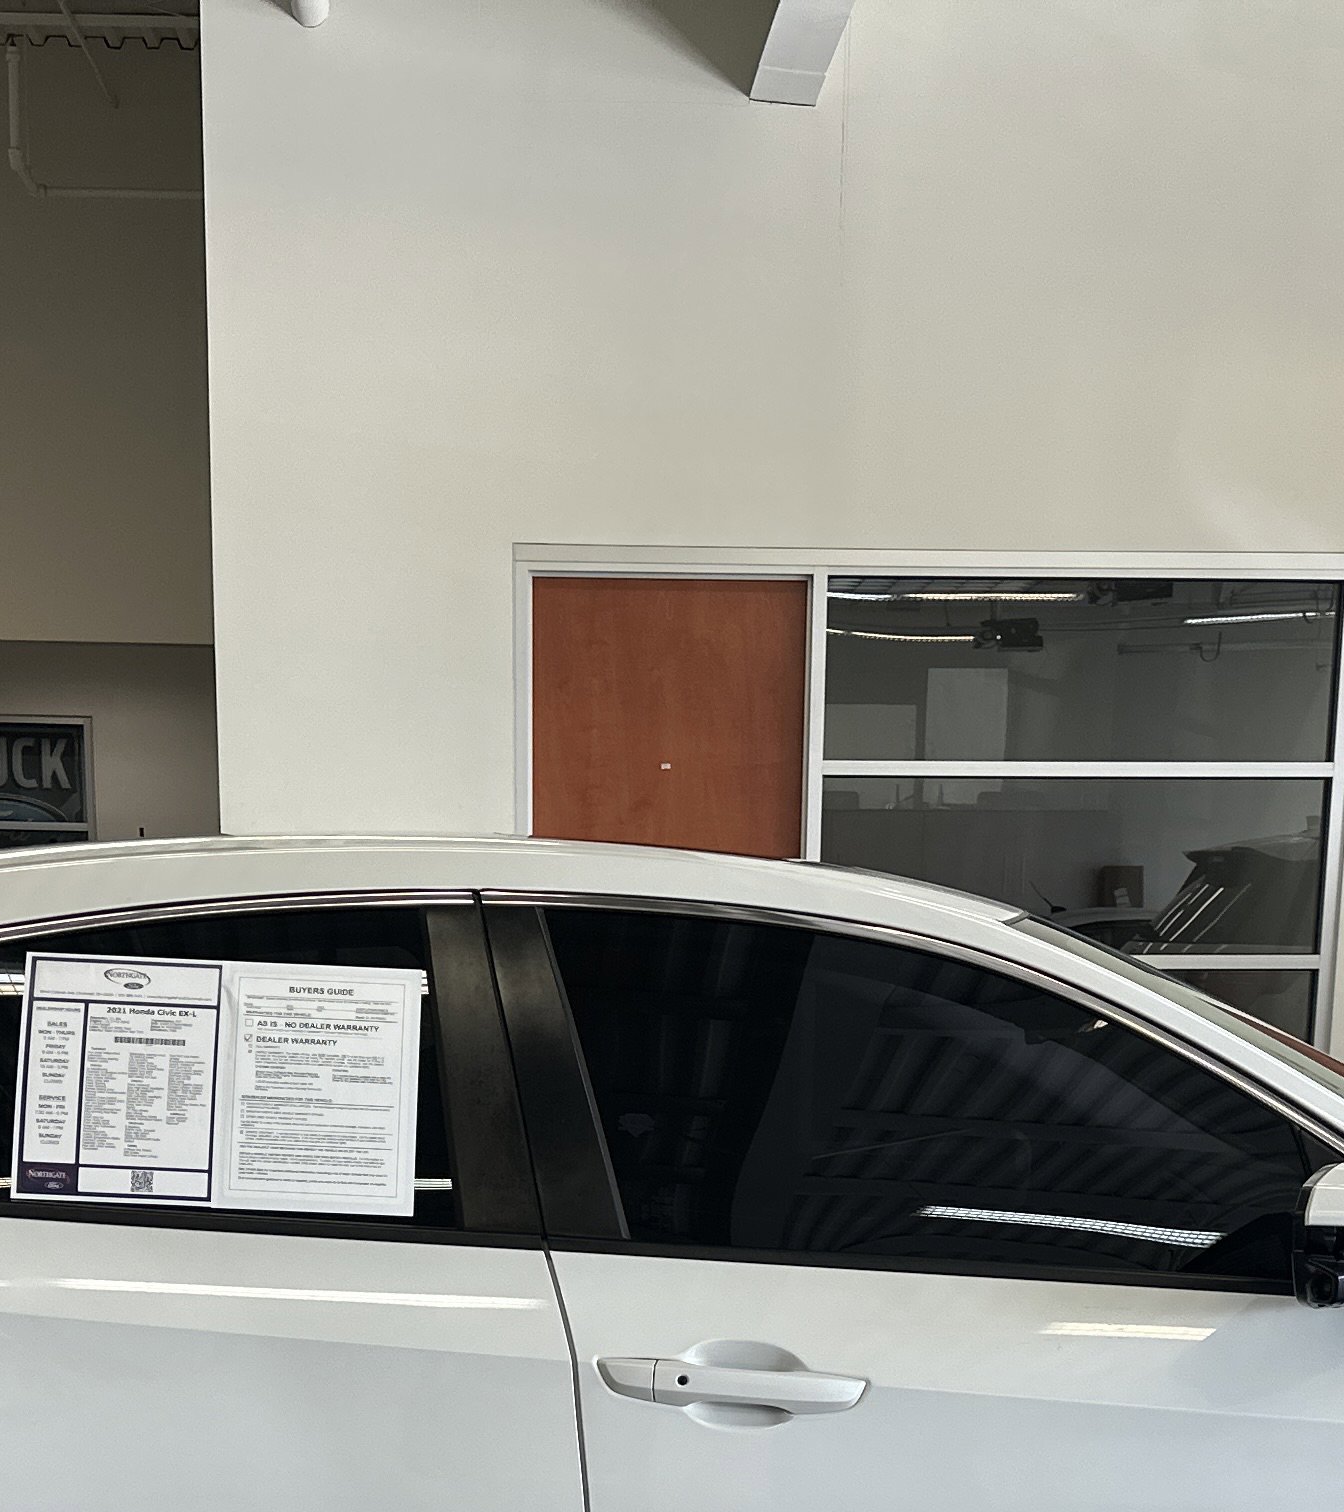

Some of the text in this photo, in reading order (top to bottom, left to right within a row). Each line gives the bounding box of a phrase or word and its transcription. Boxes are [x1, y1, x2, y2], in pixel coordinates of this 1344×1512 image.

[288, 986, 355, 996] BUYERS GUIDE
[106, 1006, 126, 1014] 2021
[299, 1022, 331, 1030] DEALER
[333, 1024, 380, 1032] WARRANTY
[256, 1036, 338, 1046] DEALER WARRANTY
